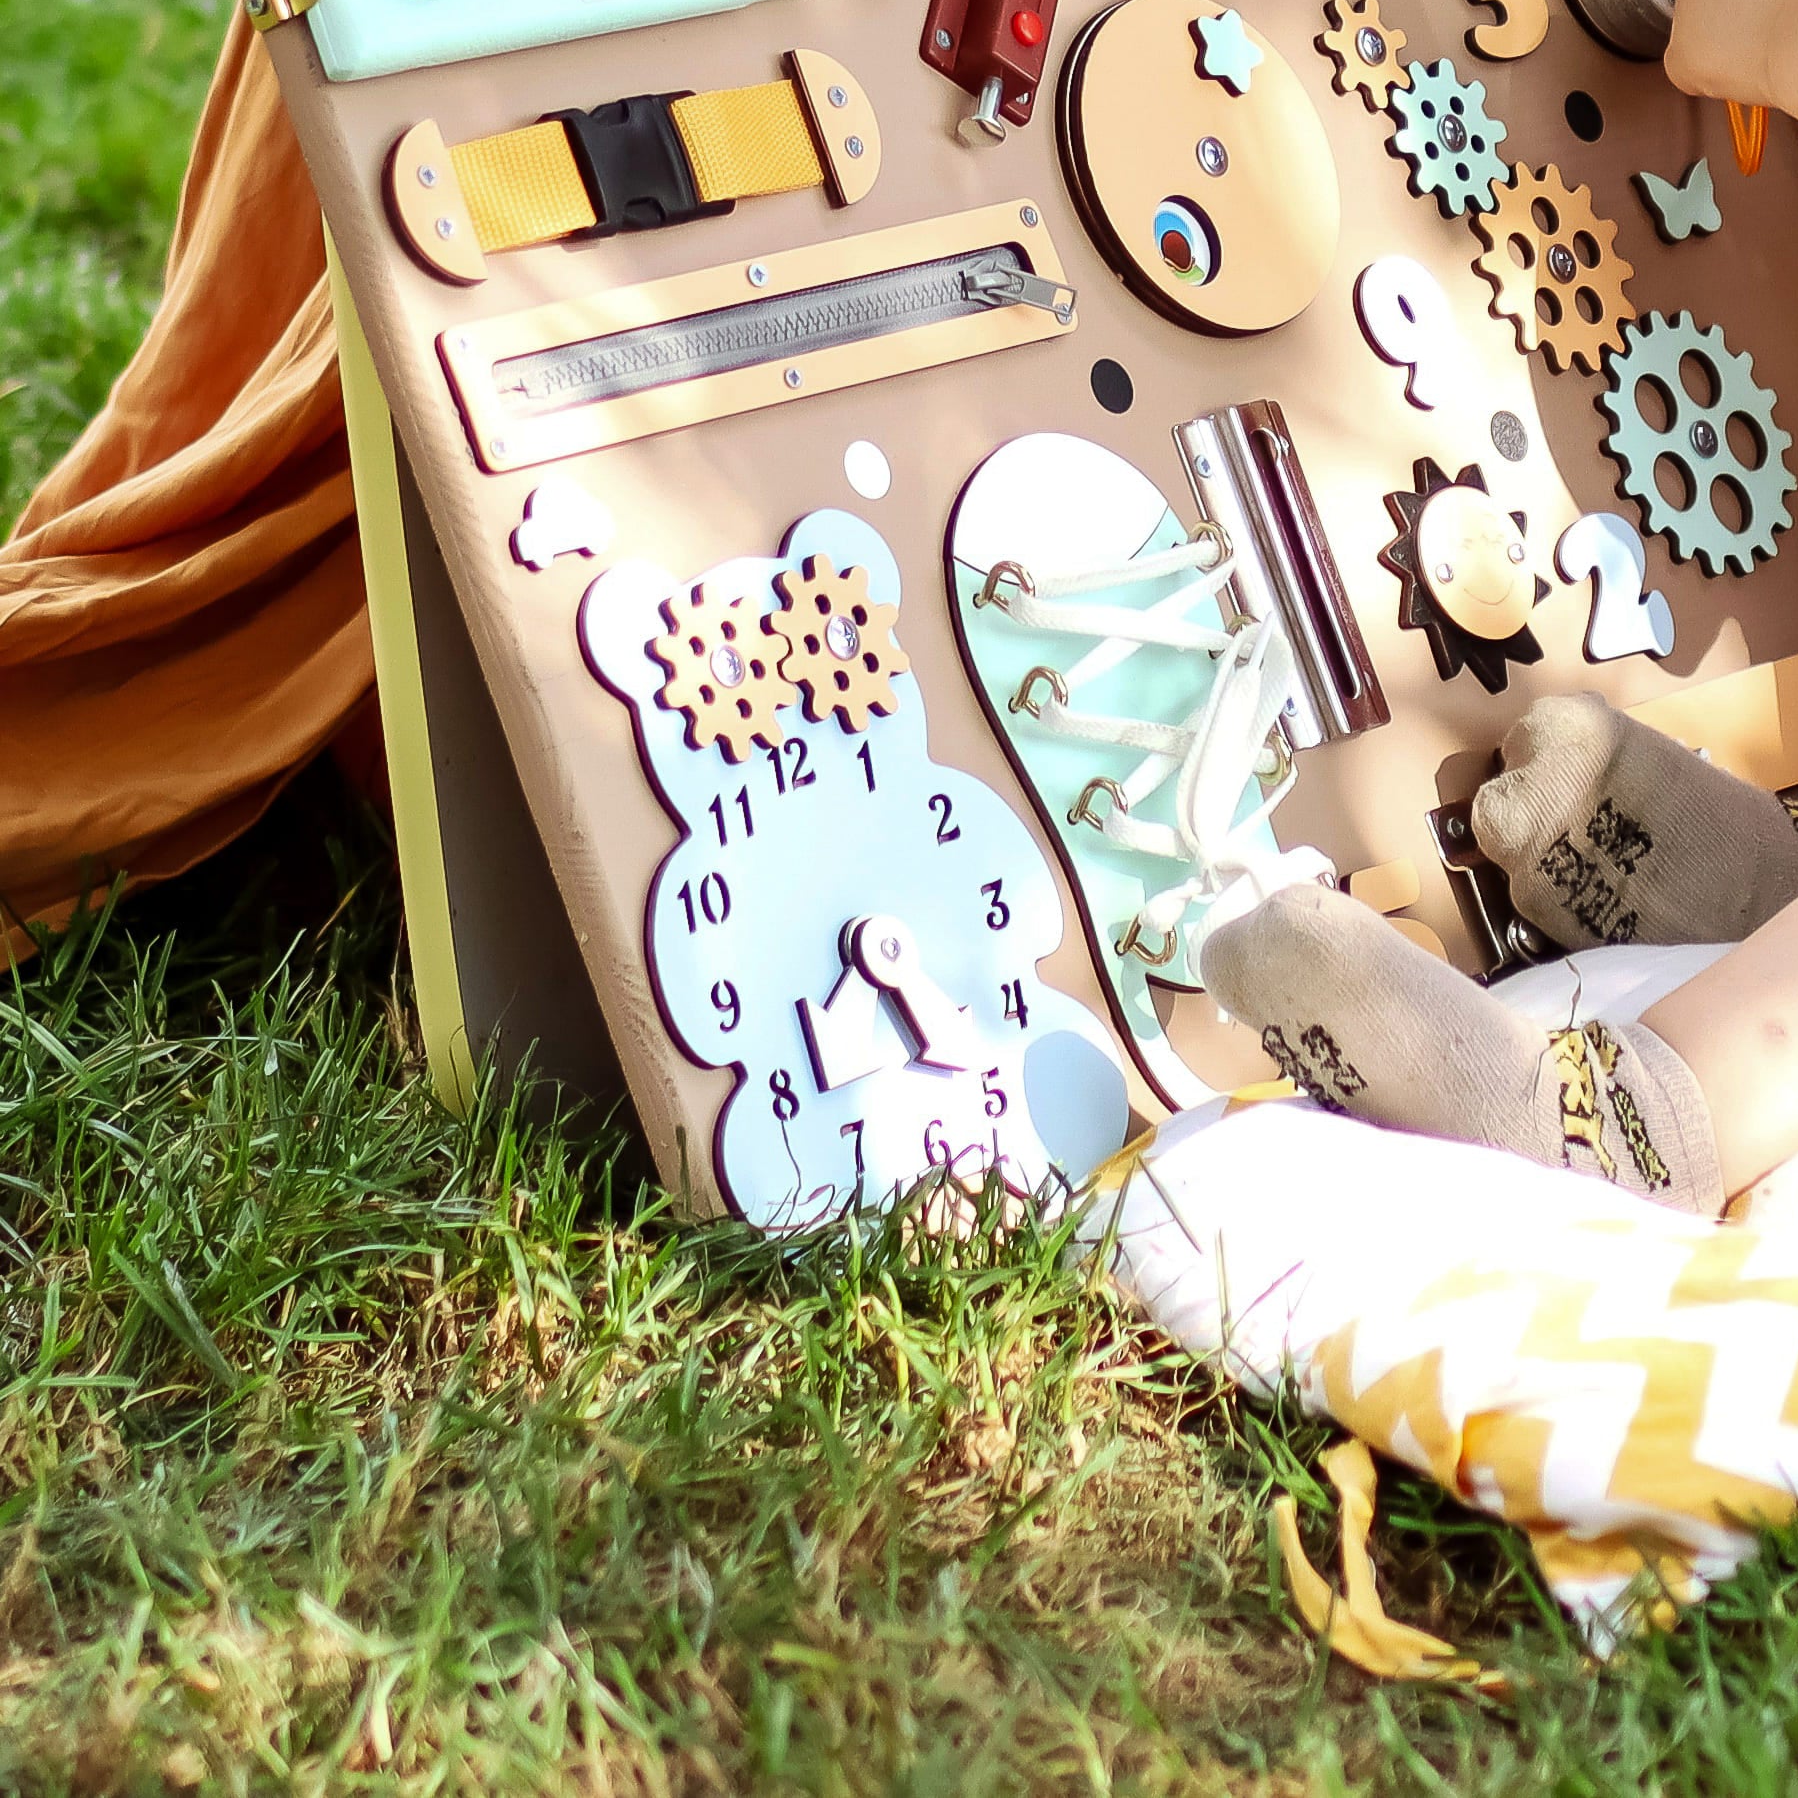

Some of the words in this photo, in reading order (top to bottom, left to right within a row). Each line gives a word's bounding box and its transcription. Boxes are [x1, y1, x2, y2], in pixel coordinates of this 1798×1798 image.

[1353, 255, 1458, 415] 9
[1555, 512, 1675, 663] 2
[767, 737, 816, 795] 12
[857, 739, 876, 794] 1
[708, 784, 755, 847] 11
[928, 793, 961, 847] 2
[677, 871, 732, 935] 10
[980, 879, 1010, 931] 3
[711, 979, 741, 1033] 9
[1000, 978, 1029, 1029] 4
[769, 1068, 800, 1121] 8
[981, 1067, 1008, 1118] 5
[839, 1119, 865, 1172] 7
[924, 1119, 950, 1167] 6
